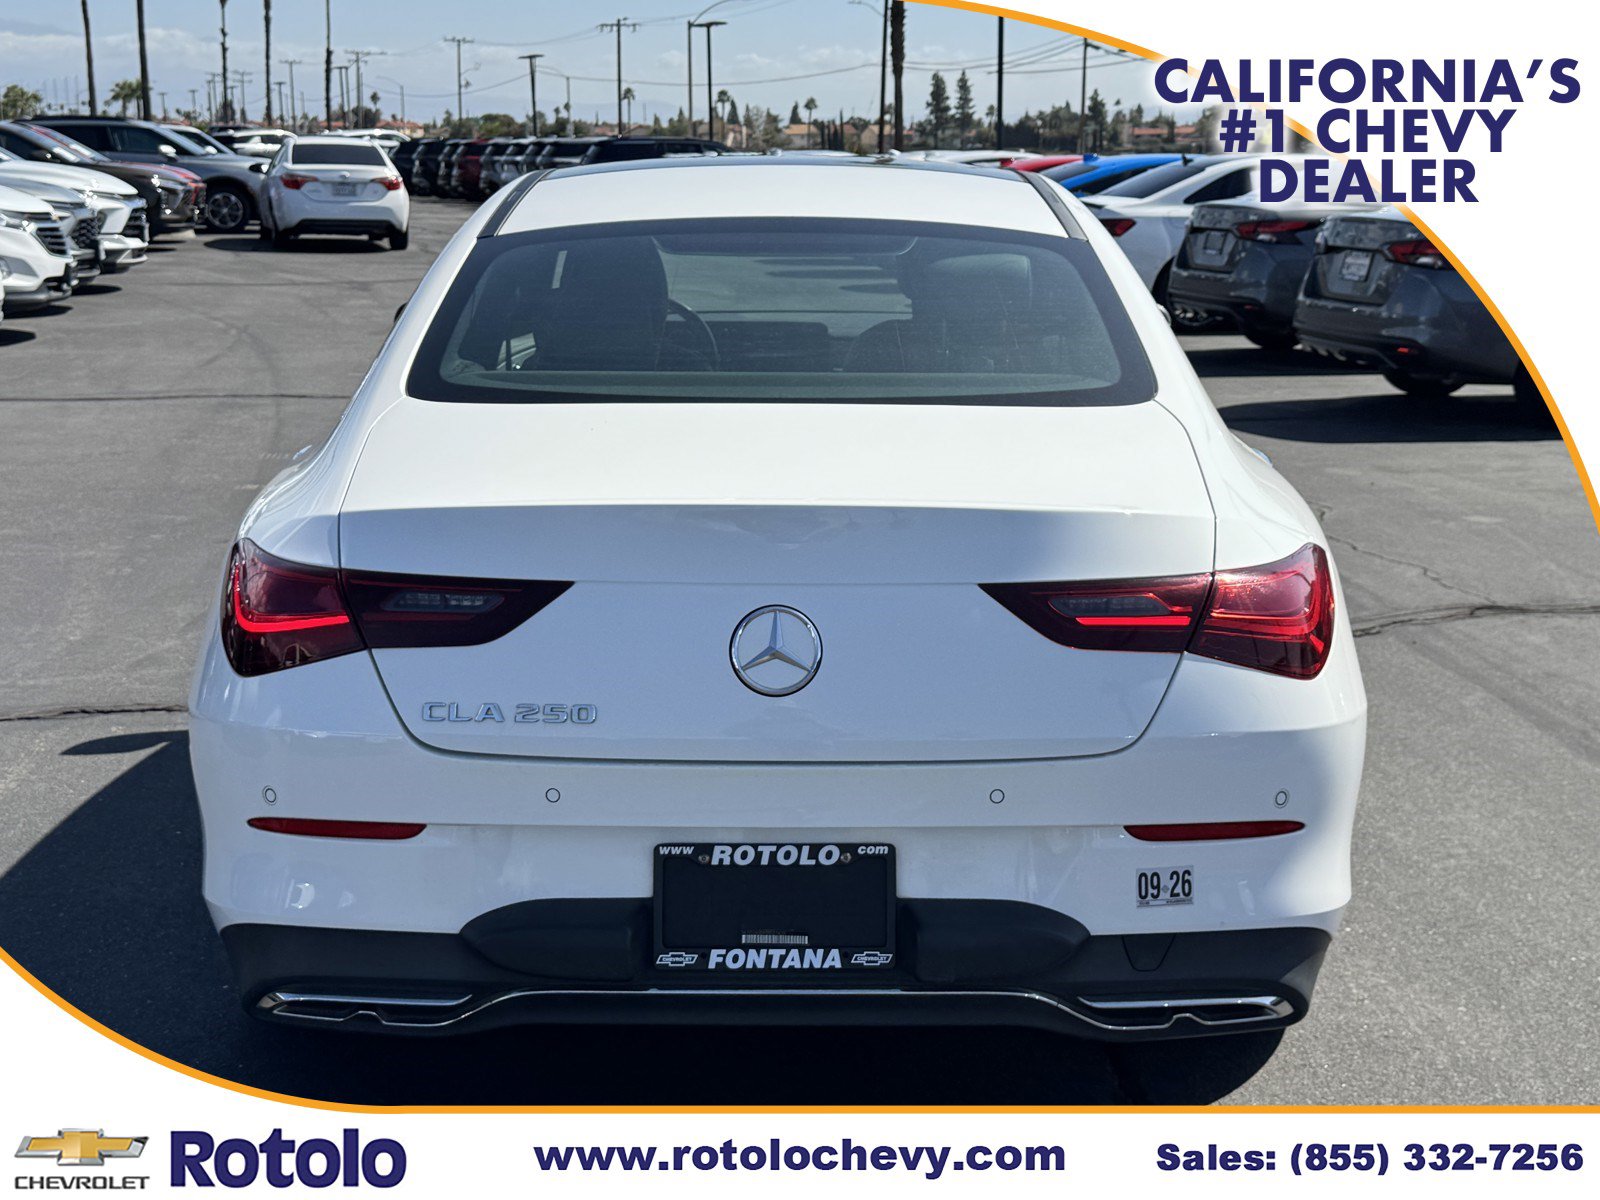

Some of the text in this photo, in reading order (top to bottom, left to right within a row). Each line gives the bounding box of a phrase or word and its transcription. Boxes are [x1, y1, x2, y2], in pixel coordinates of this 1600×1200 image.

[422, 701, 598, 724] CLA 250
[711, 844, 841, 866] ROTOLO
[1138, 870, 1192, 900] 09 26
[708, 948, 842, 970] FONTANA
